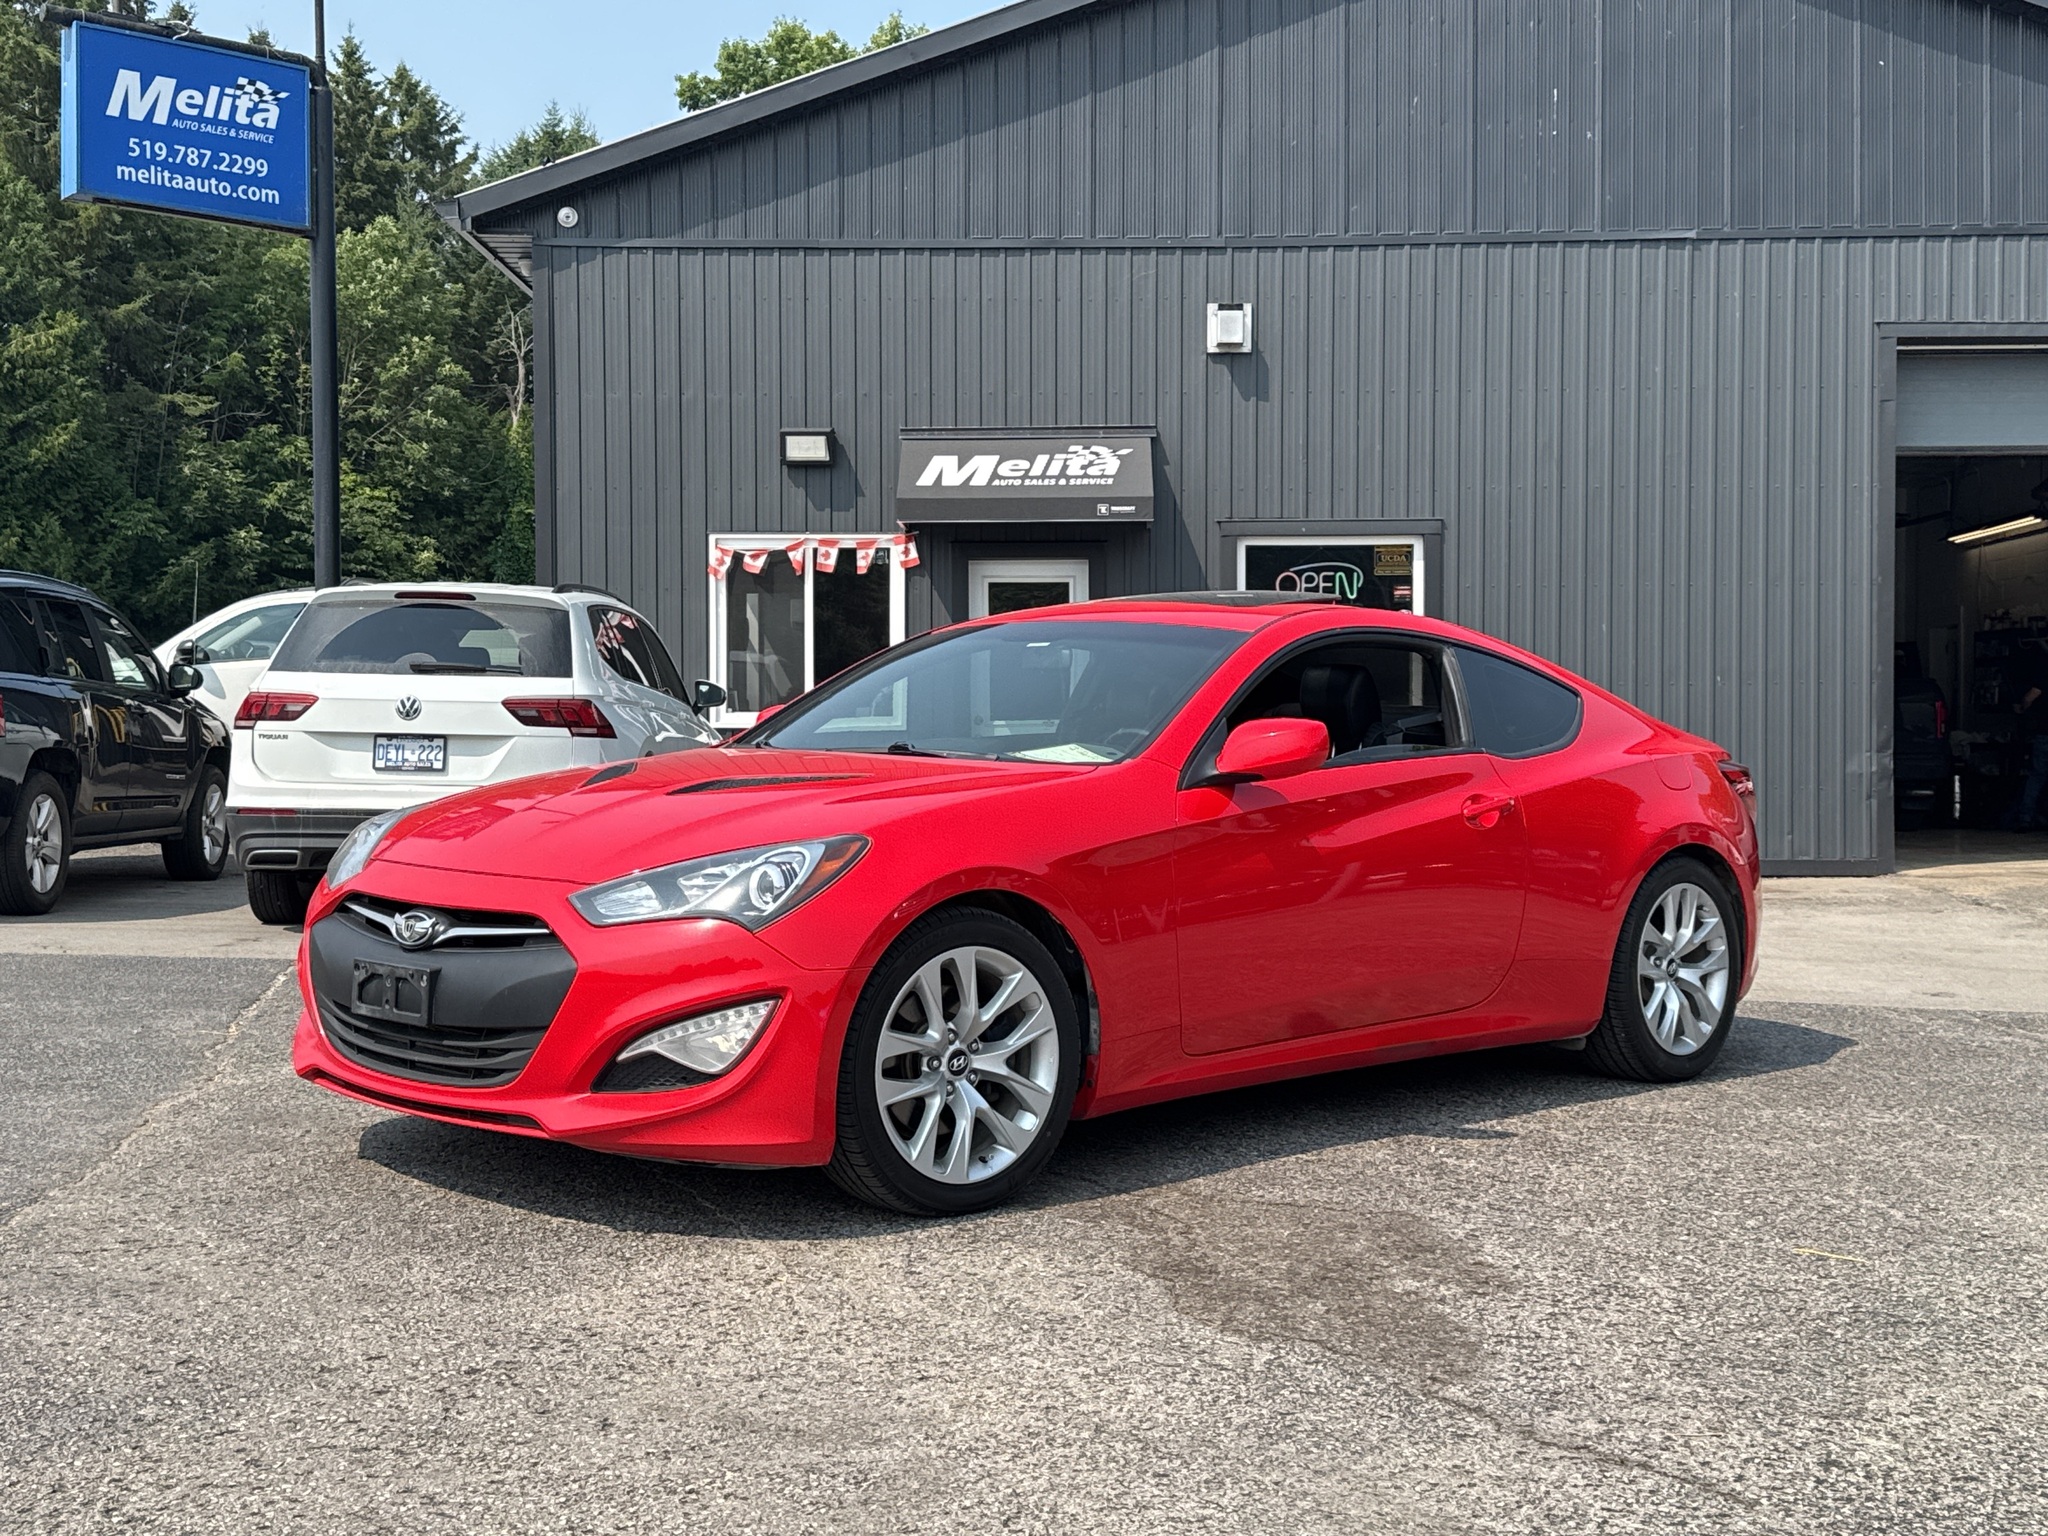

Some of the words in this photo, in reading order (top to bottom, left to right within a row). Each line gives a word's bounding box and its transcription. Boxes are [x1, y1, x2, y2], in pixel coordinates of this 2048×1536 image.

[105, 68, 281, 129] Melita
[172, 118, 199, 131] AUTO
[199, 123, 228, 136] SALES
[229, 128, 237, 137] &
[238, 129, 275, 144] SERVICE
[128, 137, 268, 177] 519.787.2299
[116, 164, 280, 204] melitaauto.com
[915, 453, 1121, 486] Melita
[991, 478, 1022, 486] AUTO
[1023, 478, 1056, 486] SALES
[1068, 477, 1114, 485] SERVICE
[1381, 554, 1407, 562] UCDA
[1275, 571, 1358, 600] OPEN
